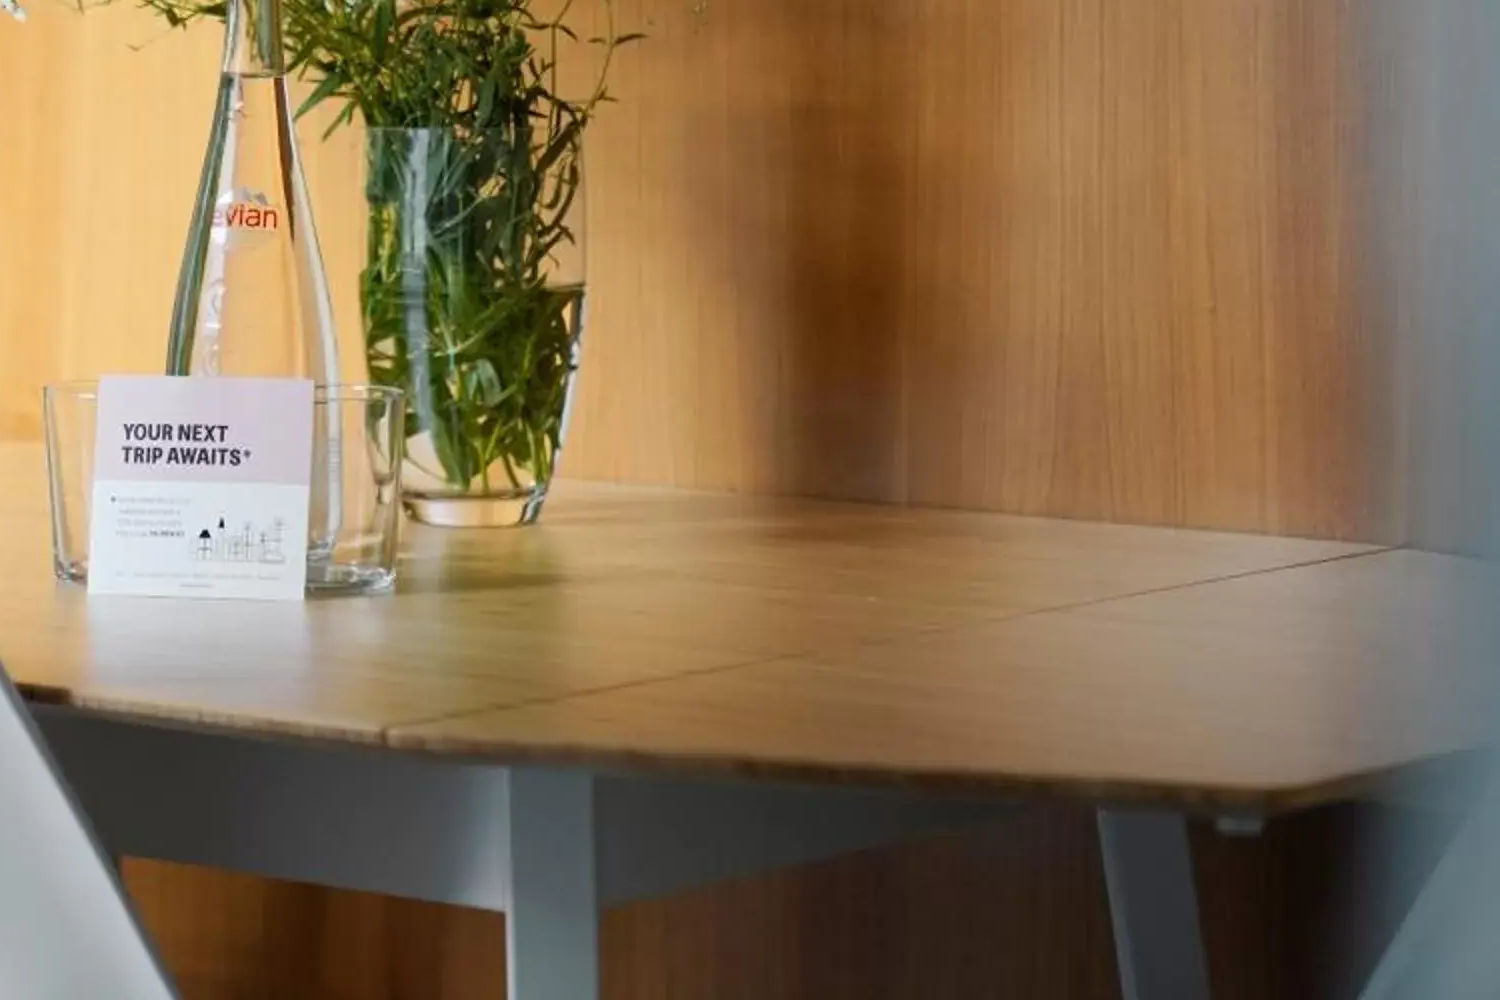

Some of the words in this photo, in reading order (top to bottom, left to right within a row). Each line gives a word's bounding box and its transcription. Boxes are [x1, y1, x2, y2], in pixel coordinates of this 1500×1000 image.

[123, 423, 174, 441] YOUR
[177, 423, 229, 443] NEXT
[121, 445, 164, 464] TRIP
